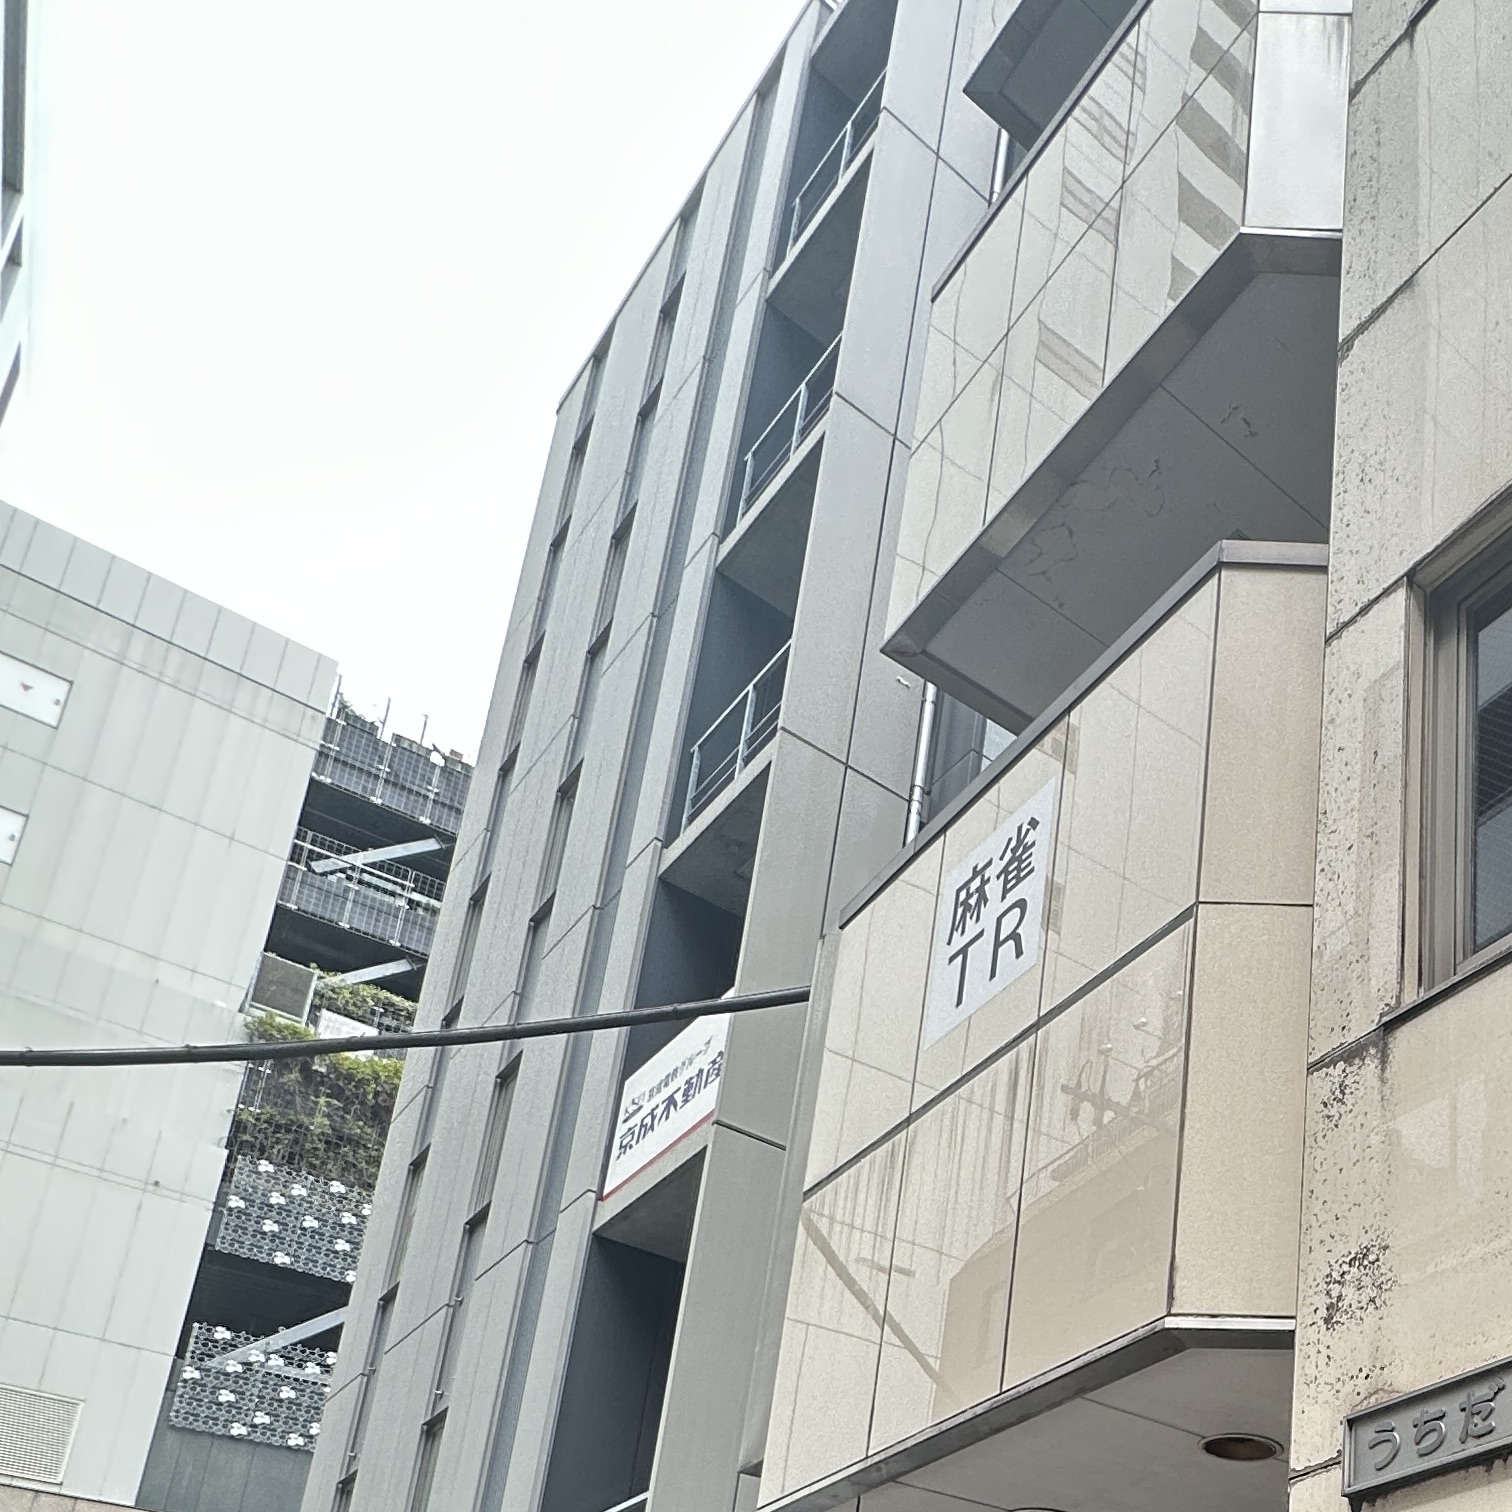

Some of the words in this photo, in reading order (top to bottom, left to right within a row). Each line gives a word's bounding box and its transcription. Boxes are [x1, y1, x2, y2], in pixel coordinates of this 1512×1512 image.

[946, 816, 1040, 946] 麻雀
[947, 897, 1028, 1009] TR
[615, 1049, 724, 1162] 京成不動産
